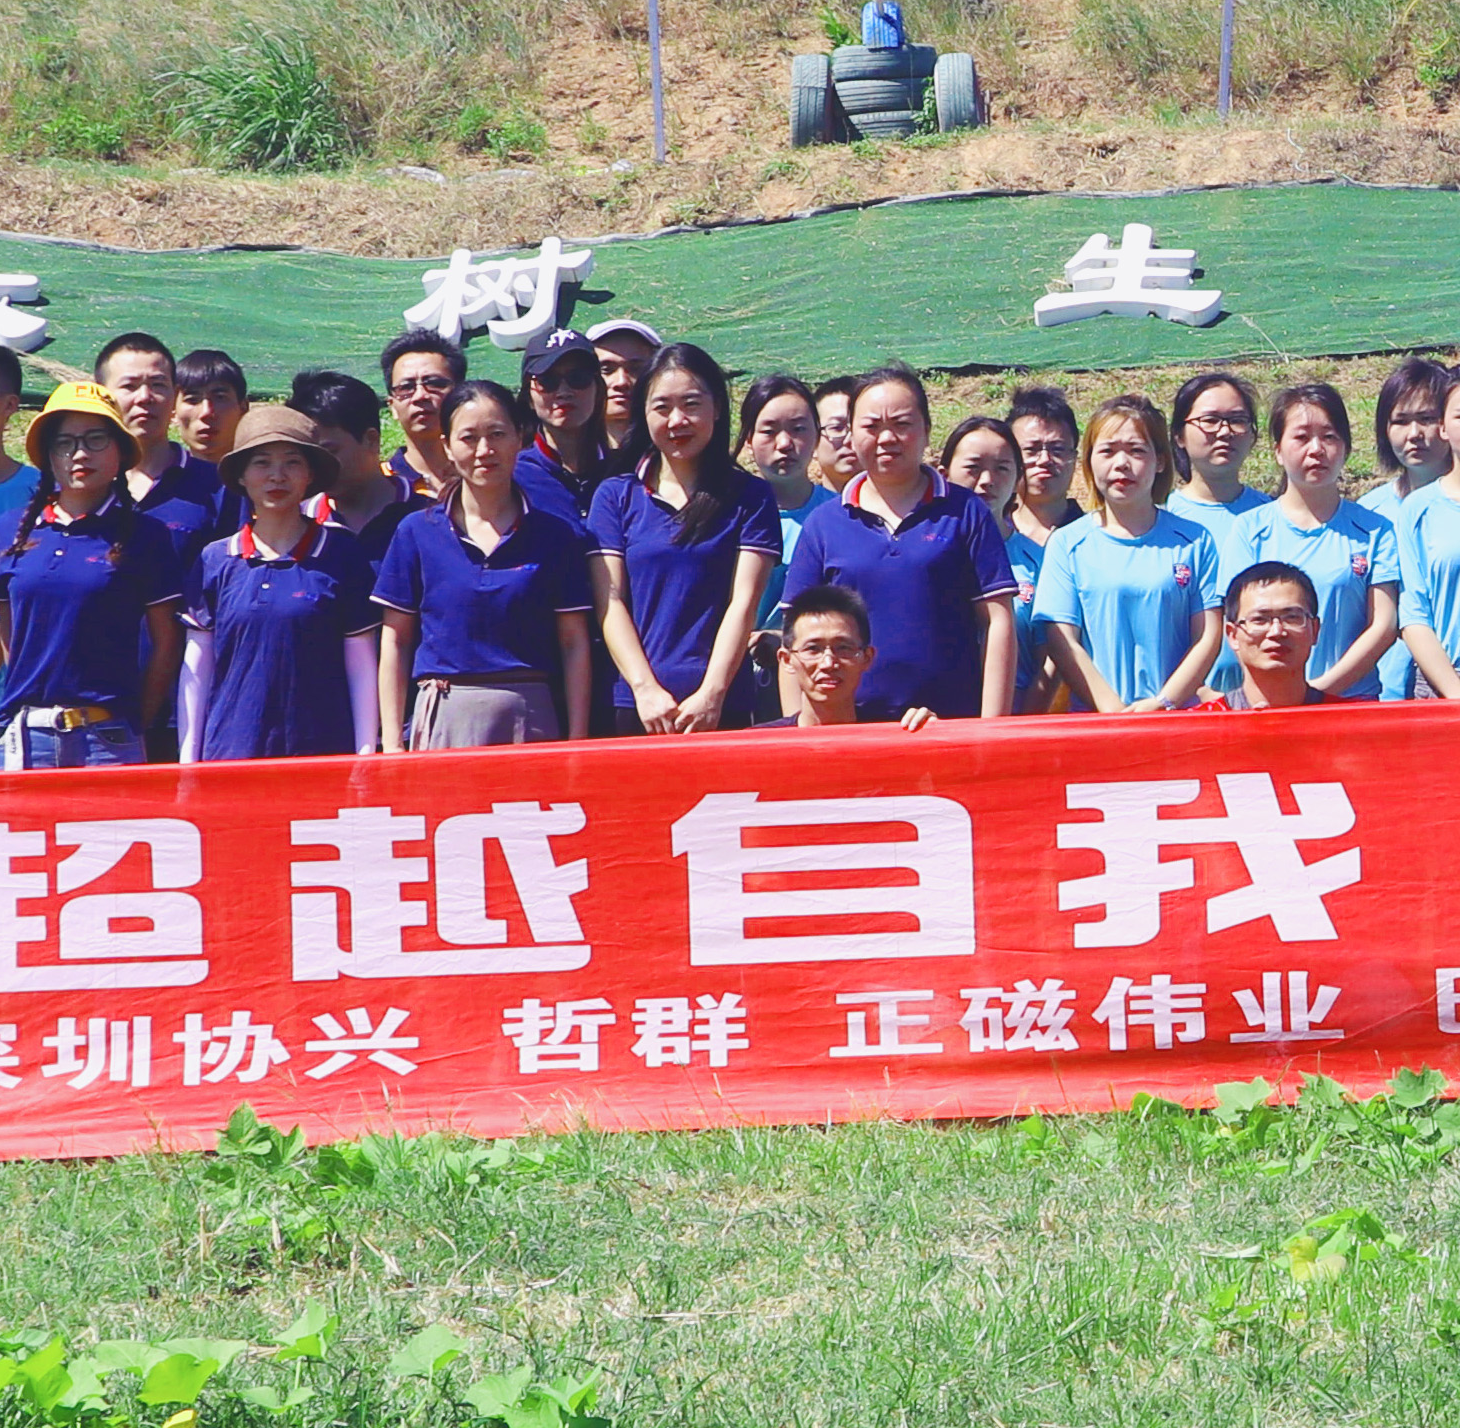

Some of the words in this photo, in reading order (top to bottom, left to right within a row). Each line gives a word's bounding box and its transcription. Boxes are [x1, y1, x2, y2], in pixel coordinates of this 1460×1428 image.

[501, 989, 750, 1074] 哲群
[828, 971, 1343, 1059] 正磁伟业
